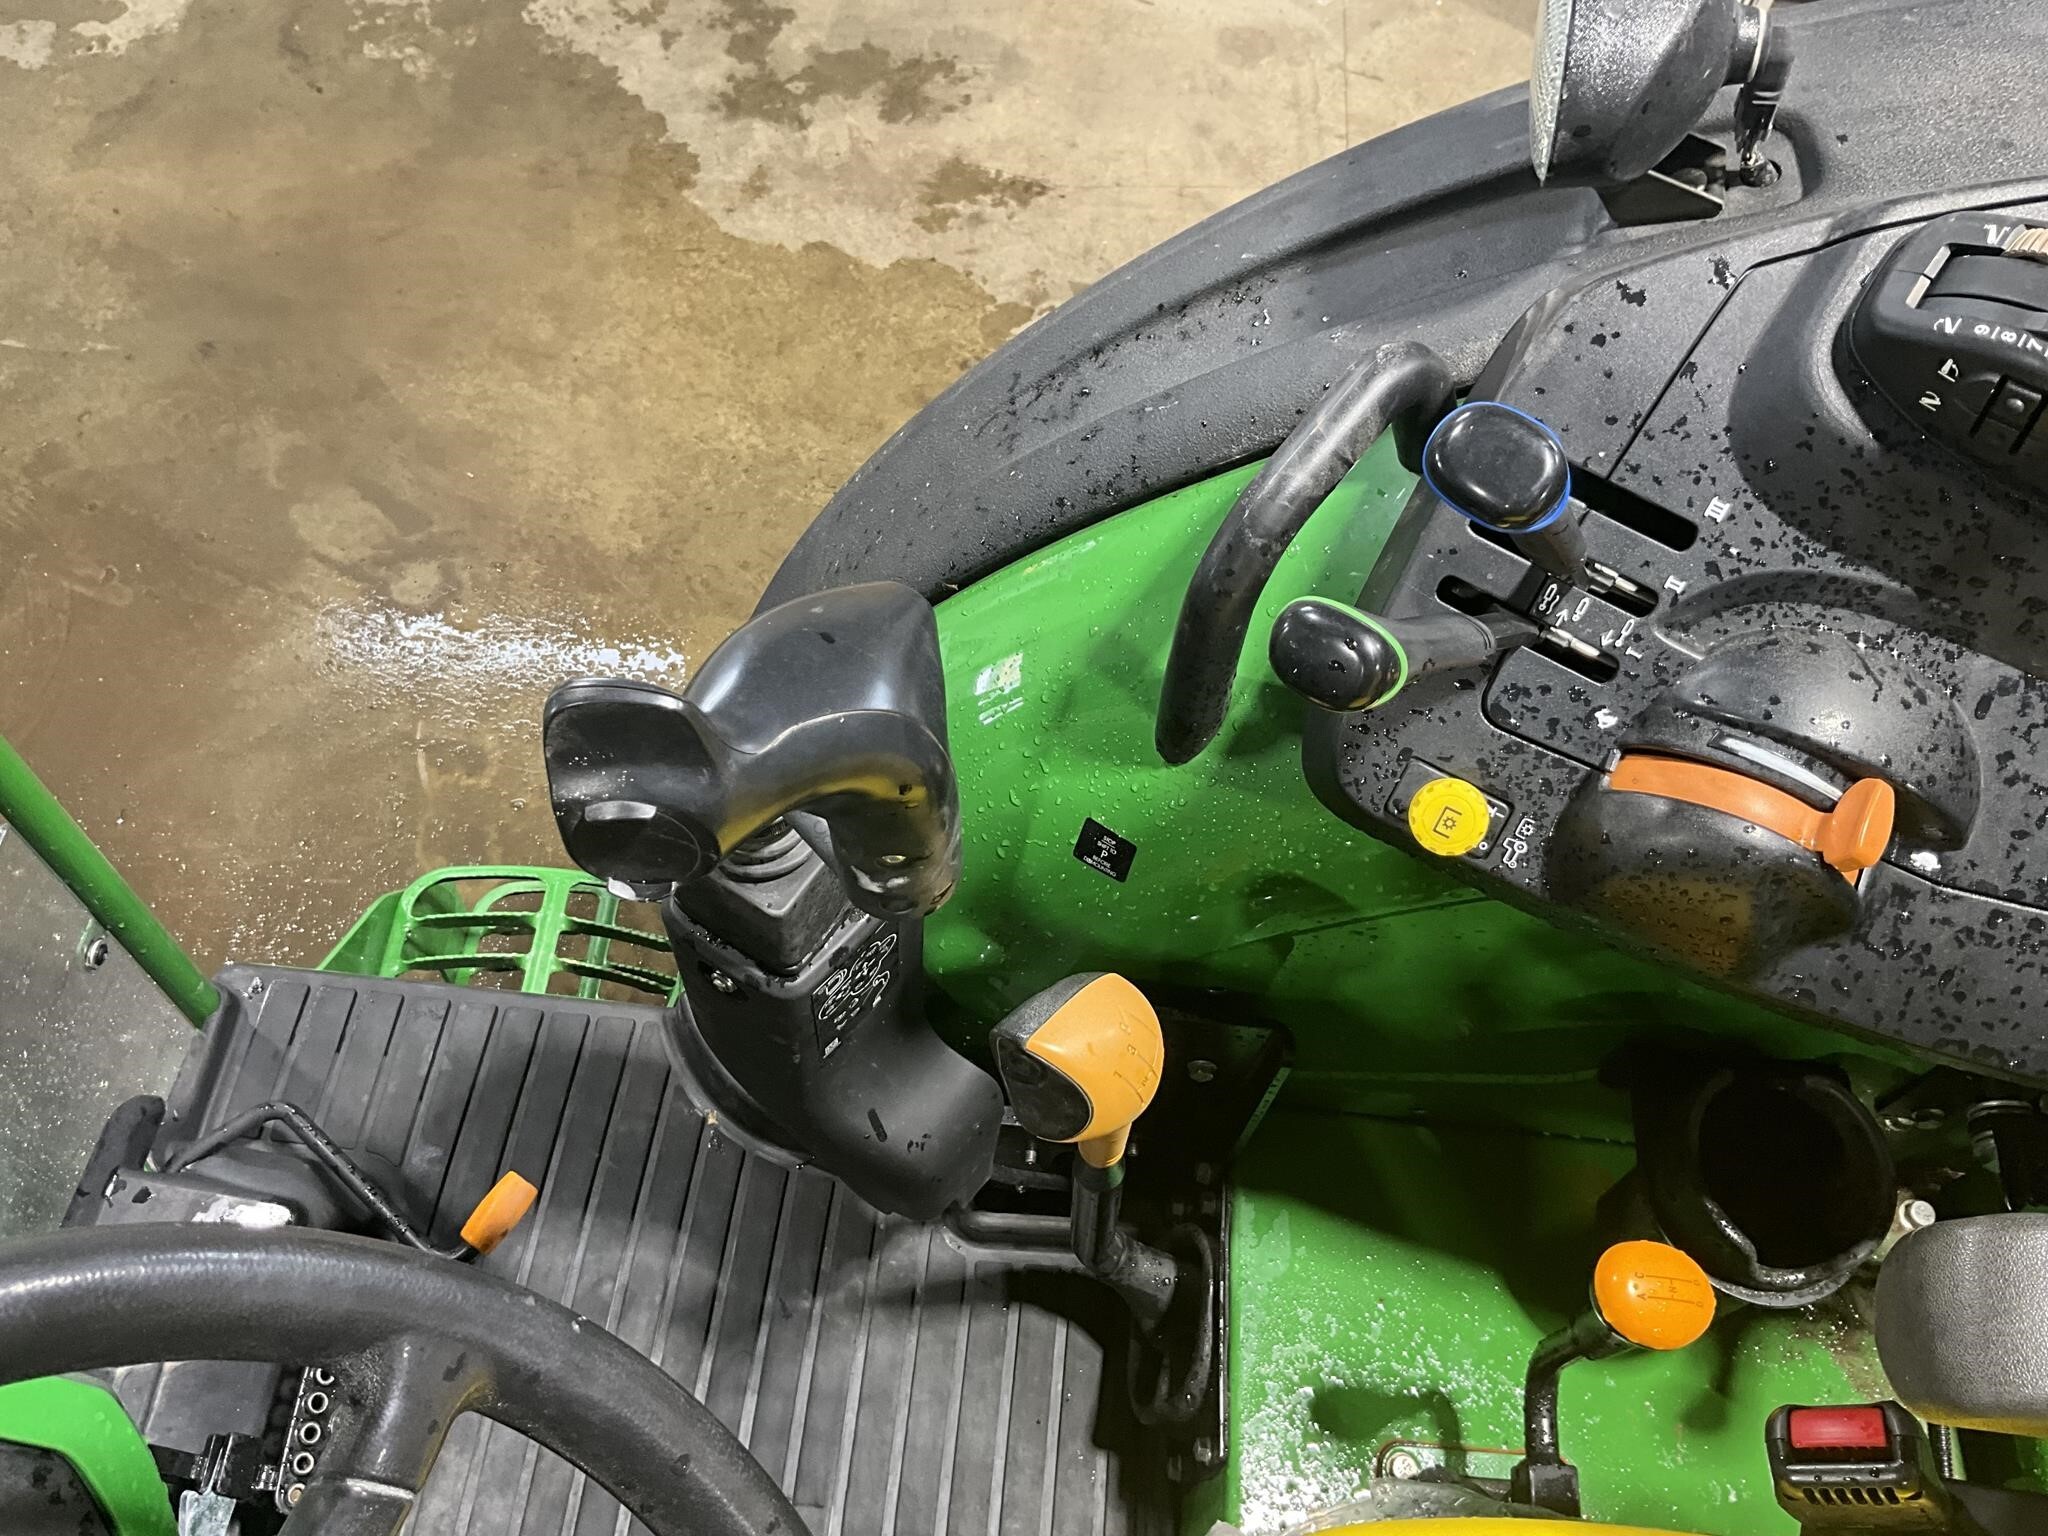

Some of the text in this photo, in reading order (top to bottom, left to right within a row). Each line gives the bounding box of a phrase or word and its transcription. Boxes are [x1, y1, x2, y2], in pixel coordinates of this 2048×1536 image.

[2001, 331, 2017, 342] 8
[1703, 495, 1730, 523] III
[1664, 575, 1687, 594] II
[1101, 850, 1108, 858] P
